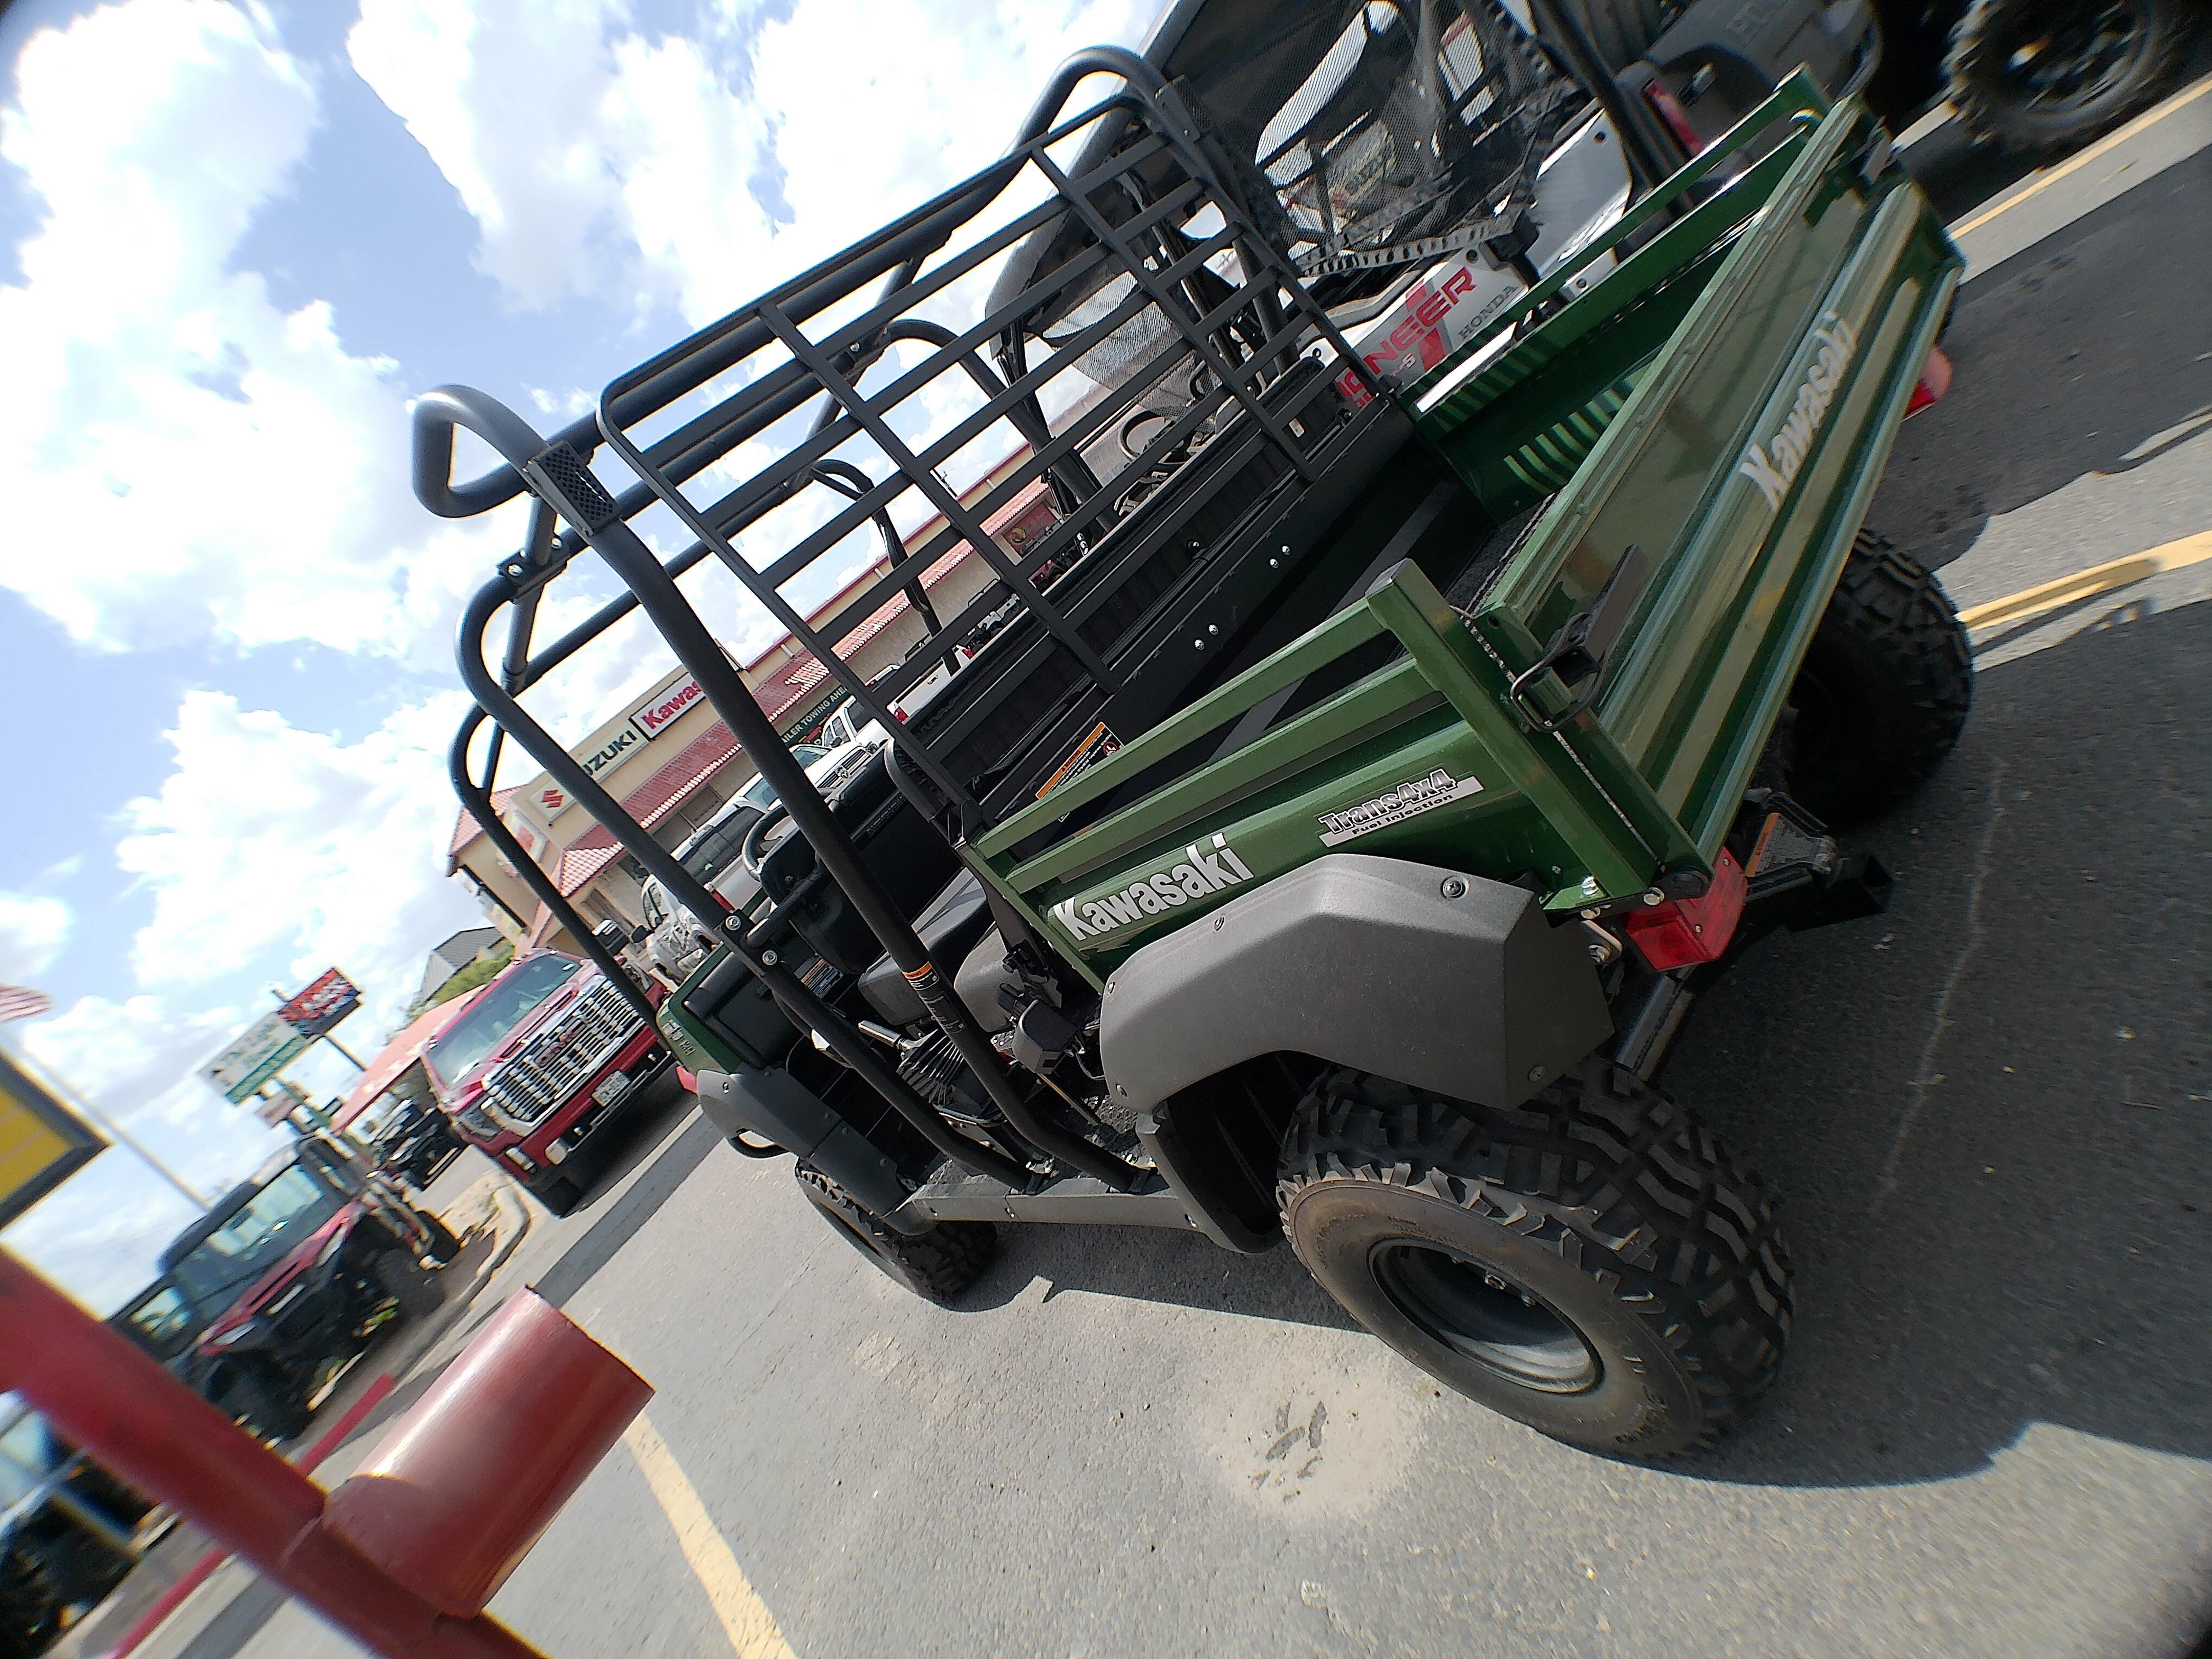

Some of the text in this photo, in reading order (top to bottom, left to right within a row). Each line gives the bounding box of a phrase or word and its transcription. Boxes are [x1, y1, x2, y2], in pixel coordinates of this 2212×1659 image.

[1337, 266, 1477, 398] IONEER
[1458, 285, 1518, 340] HONDA
[1739, 309, 1857, 513] Kawasaki
[641, 681, 702, 729] Kawas
[781, 724, 803, 743] AILER
[800, 700, 831, 726] TOWING
[830, 686, 848, 702] AHE
[582, 730, 637, 775] UZUKI
[1351, 794, 1453, 835] Fuel Injection
[1053, 833, 1254, 941] Kawasaki
[535, 1019, 586, 1066] GMC
